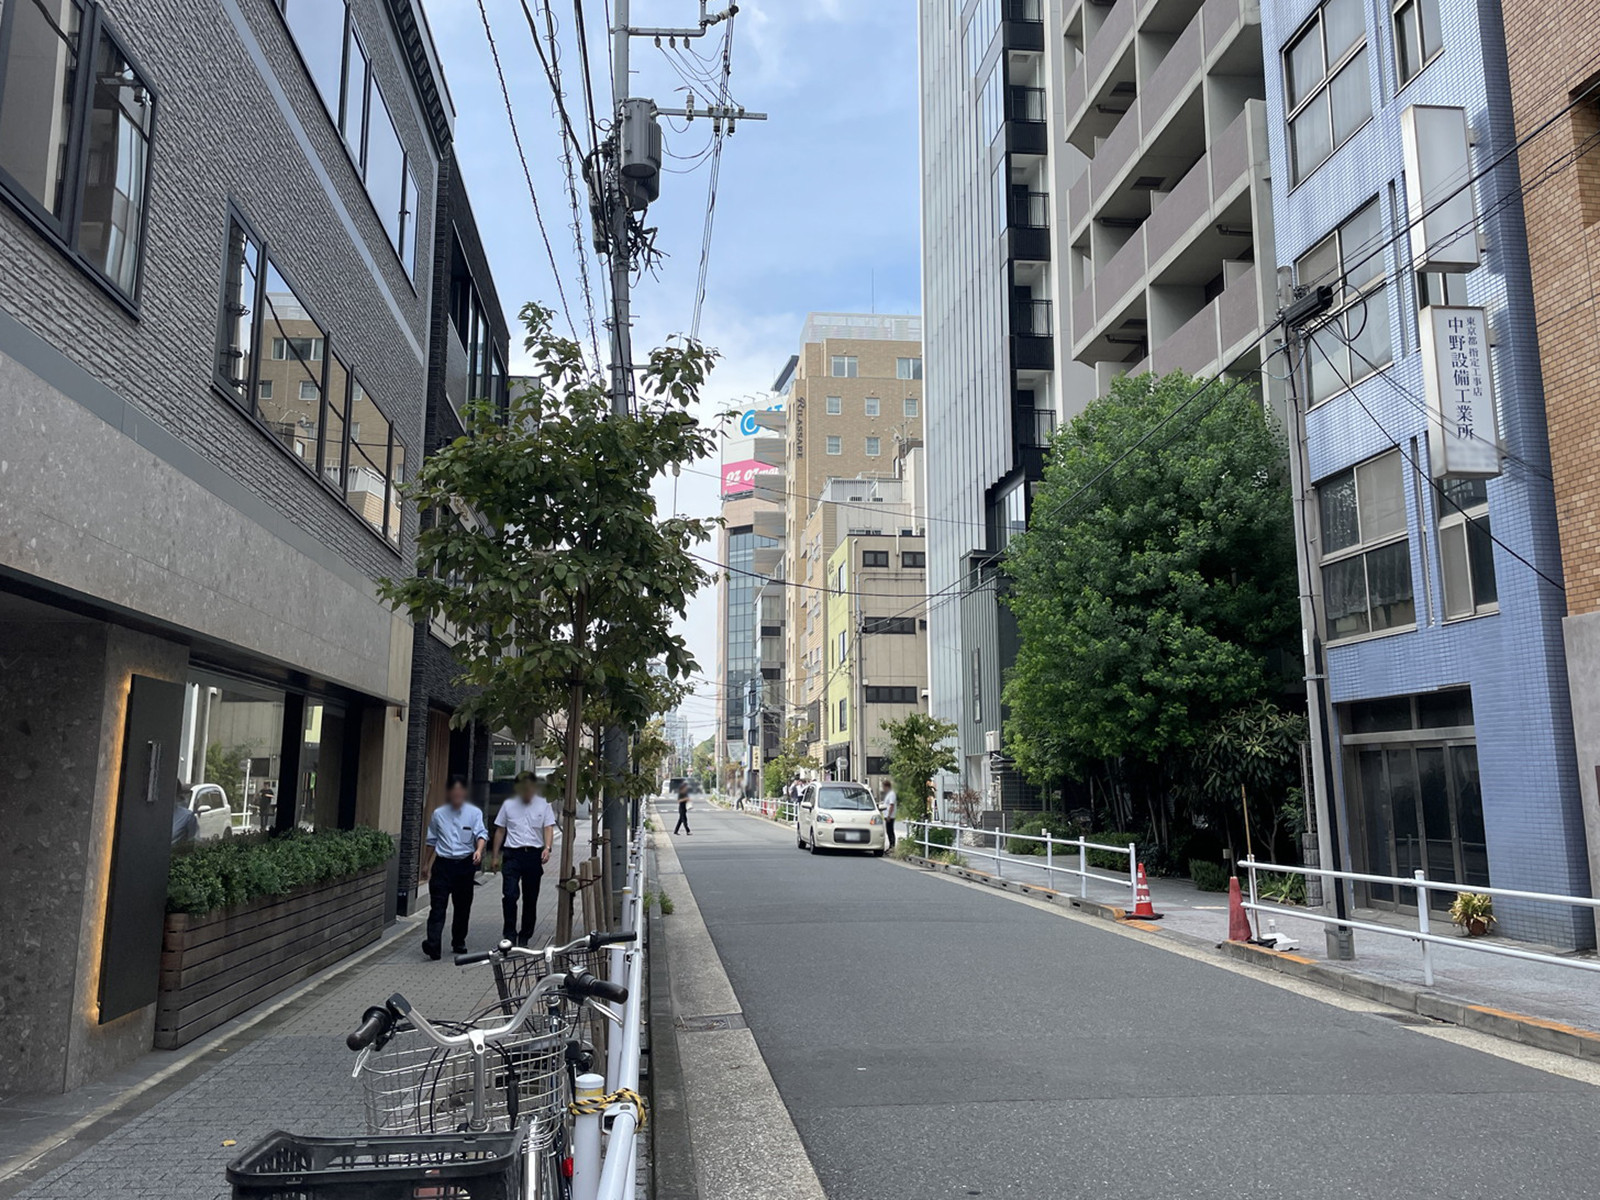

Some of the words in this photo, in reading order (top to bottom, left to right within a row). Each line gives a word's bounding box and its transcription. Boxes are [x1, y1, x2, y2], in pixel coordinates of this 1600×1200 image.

[1448, 316, 1474, 440] 中野設備工業所
